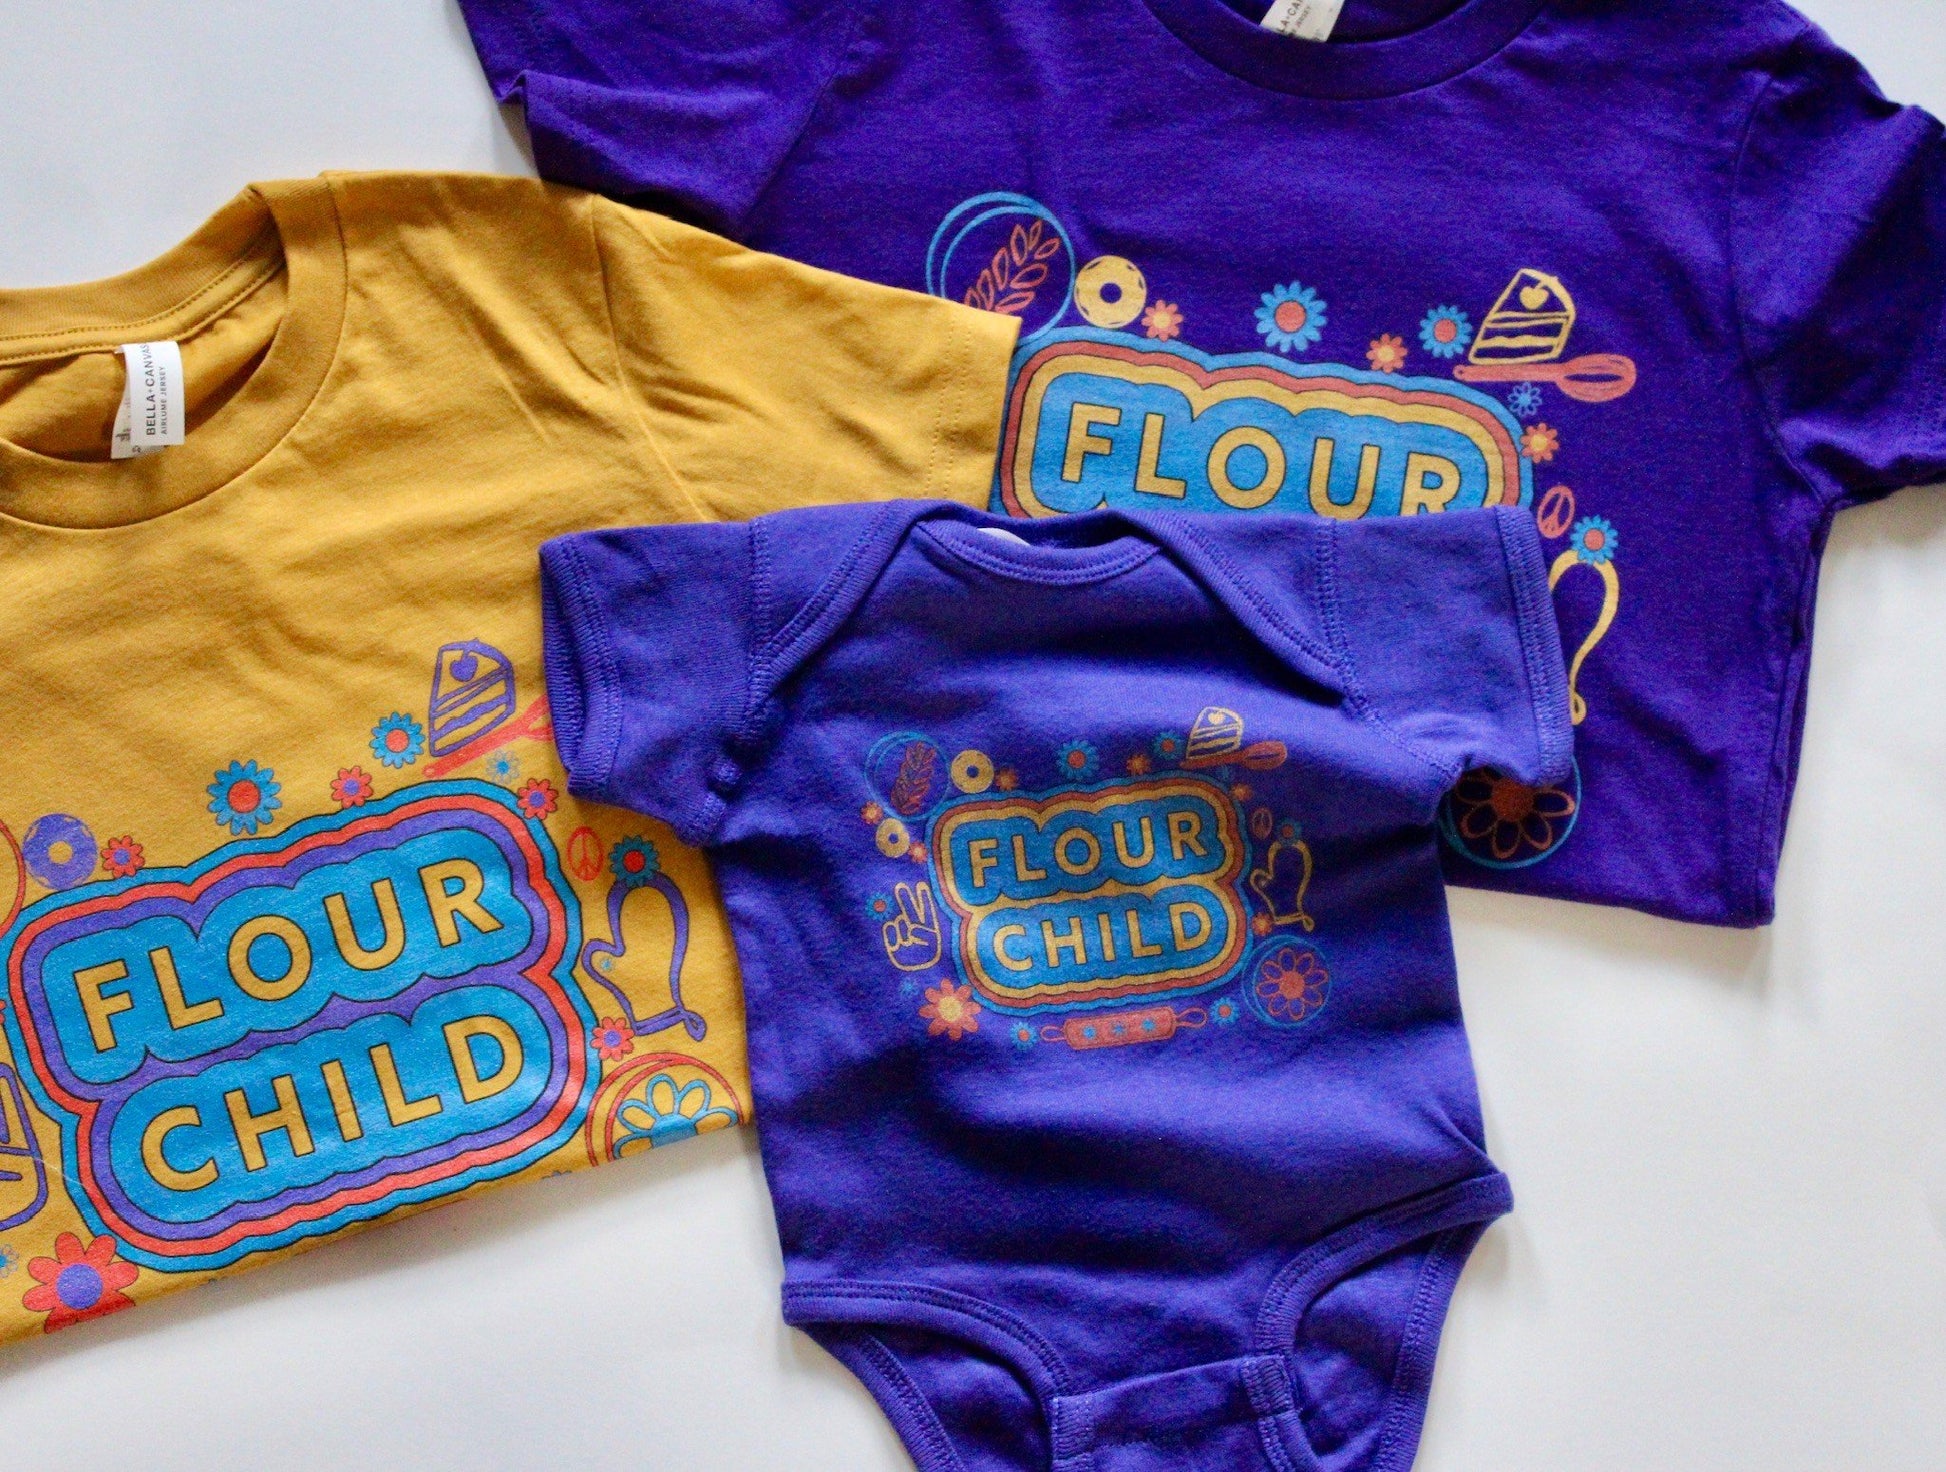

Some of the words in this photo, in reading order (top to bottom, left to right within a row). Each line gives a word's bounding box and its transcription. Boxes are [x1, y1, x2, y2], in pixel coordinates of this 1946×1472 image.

[1060, 401, 1461, 521] FLOUR
[968, 810, 1208, 889] FLOUR
[72, 858, 505, 1054] FLOUR
[992, 901, 1212, 972] CHILD
[140, 1014, 525, 1192] CHILD
